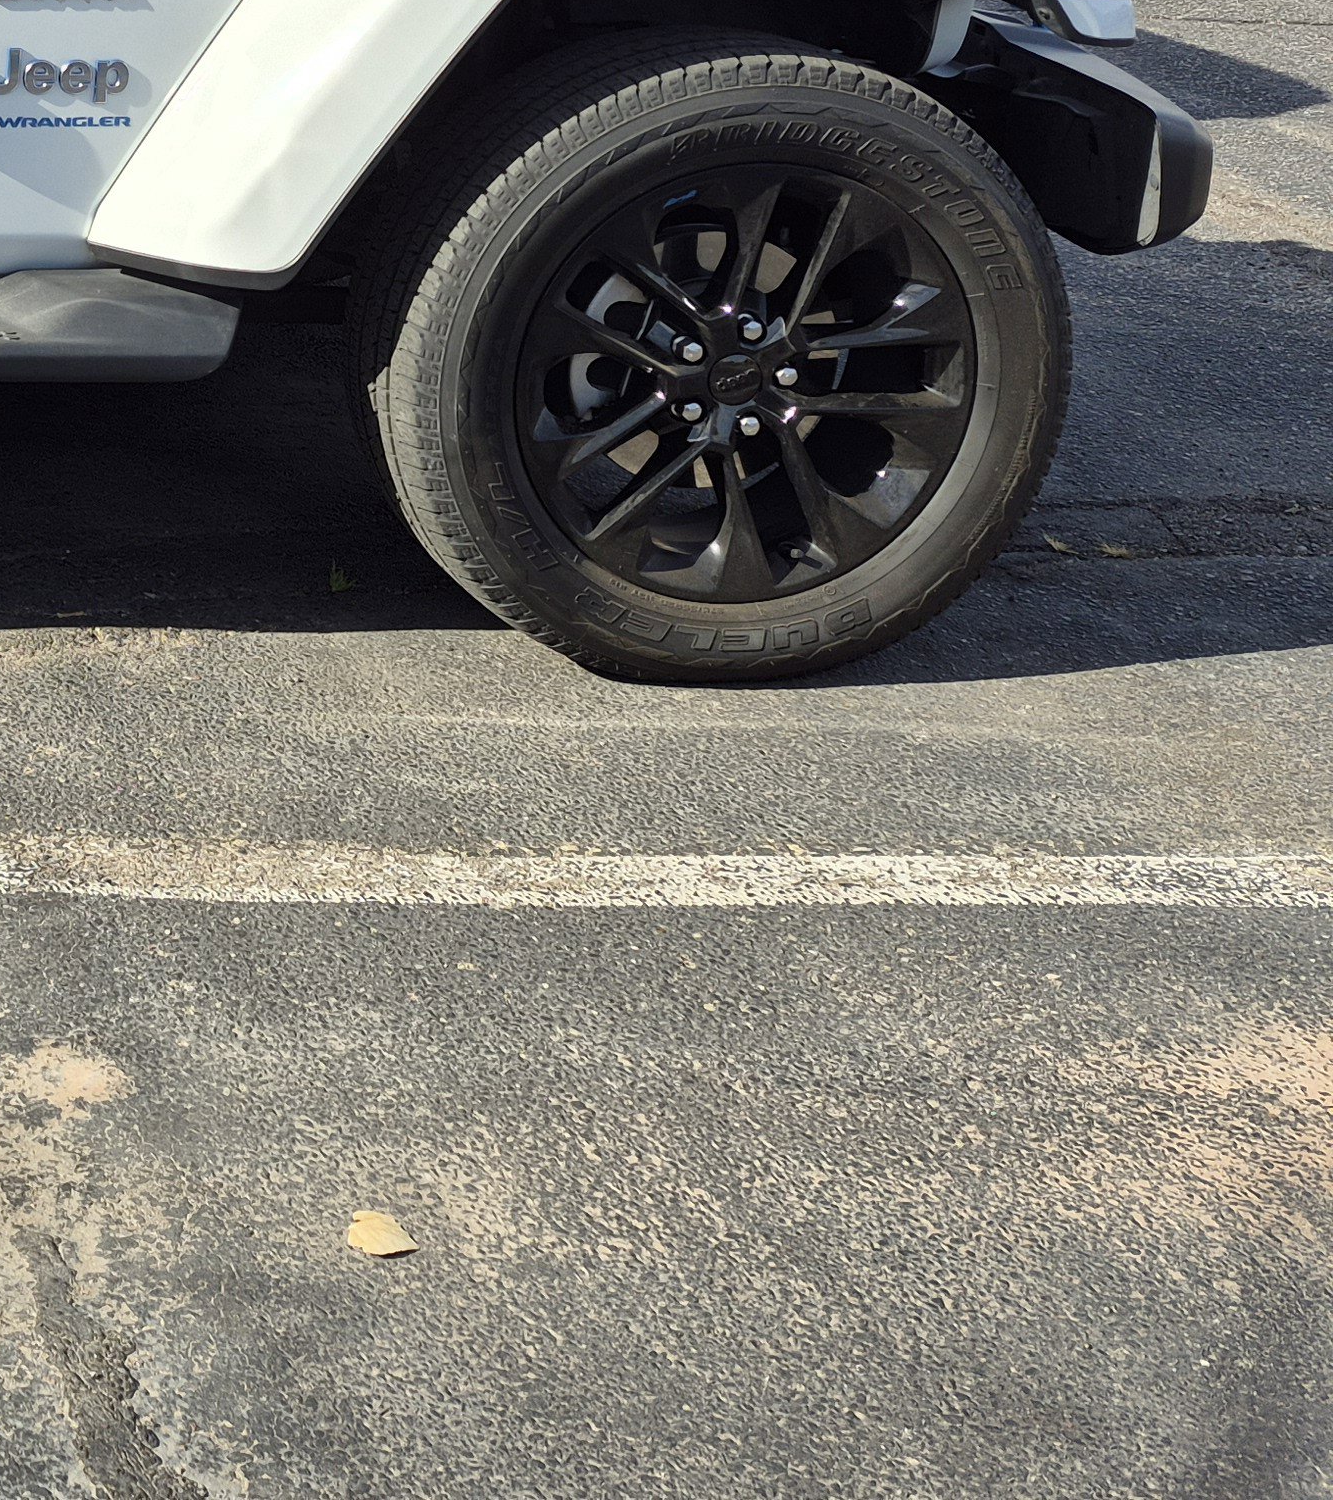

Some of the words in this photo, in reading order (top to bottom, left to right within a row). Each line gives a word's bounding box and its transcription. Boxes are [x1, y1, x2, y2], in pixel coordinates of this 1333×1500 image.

[667, 118, 1023, 291] BRIDGESTONE
[488, 461, 559, 571] H/L
[574, 585, 872, 653] DUELER
